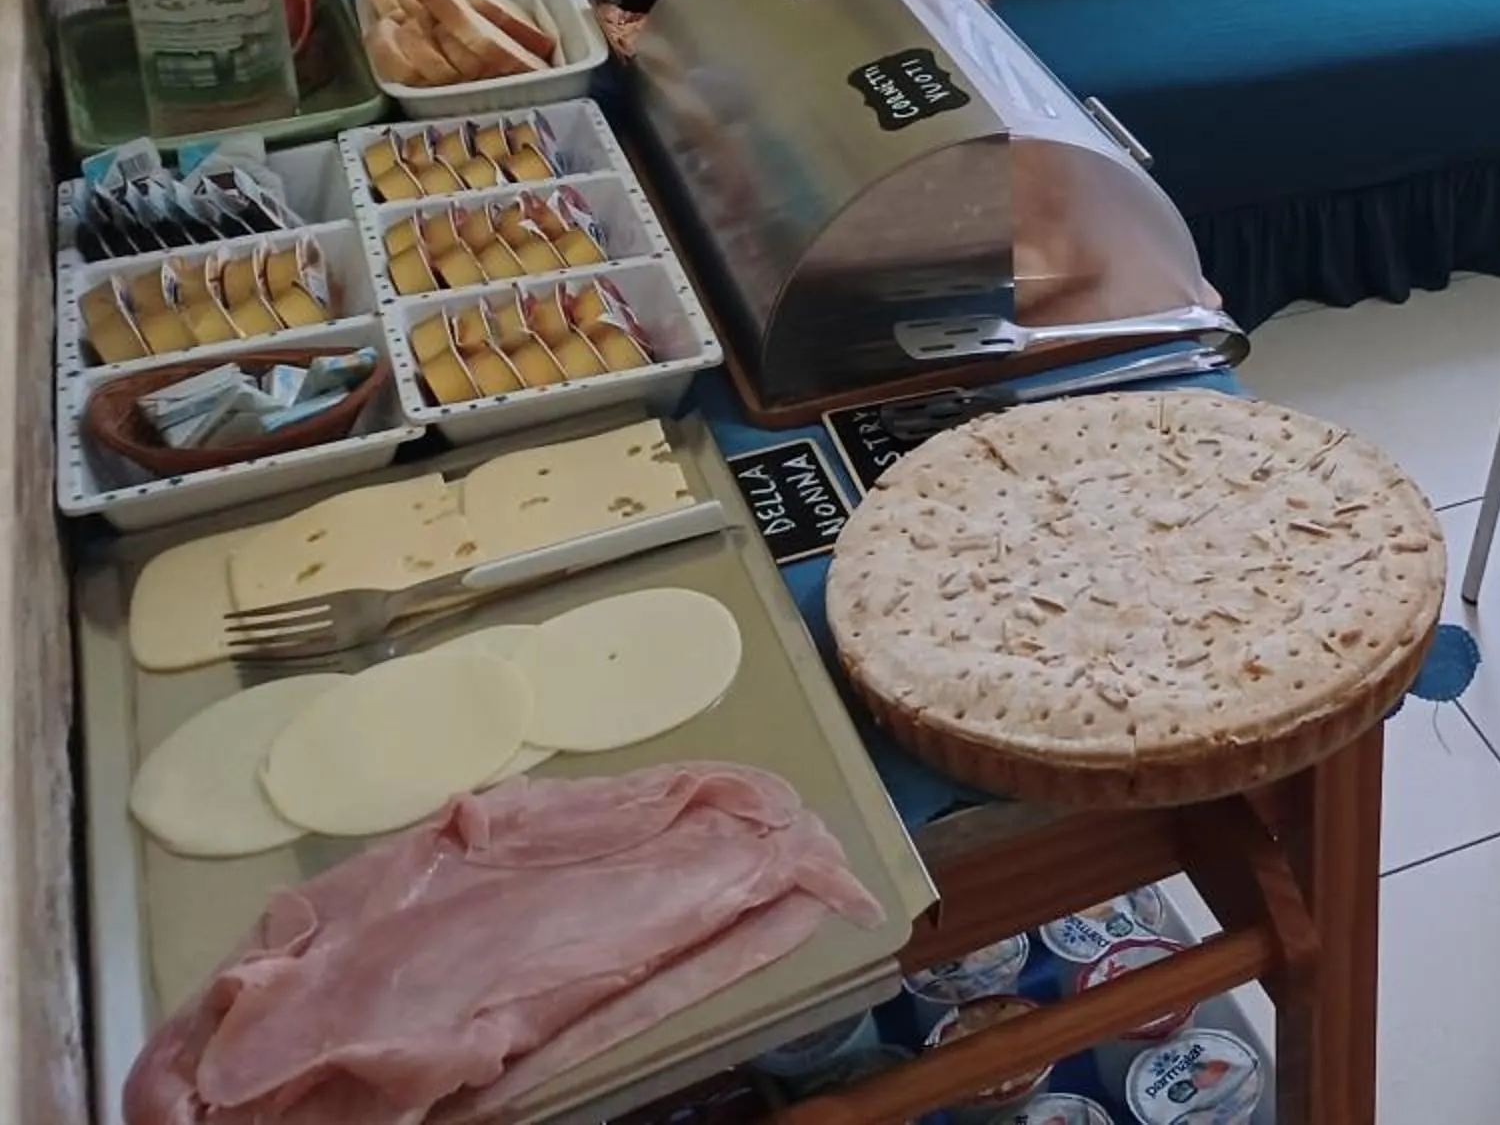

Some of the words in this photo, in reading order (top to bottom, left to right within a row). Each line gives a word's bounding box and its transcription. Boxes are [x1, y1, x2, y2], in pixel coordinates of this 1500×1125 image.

[865, 65, 919, 118] CORNETTI
[738, 464, 797, 536] DELLA
[781, 453, 848, 537] NONNA
[1145, 1043, 1206, 1100] parmalat
